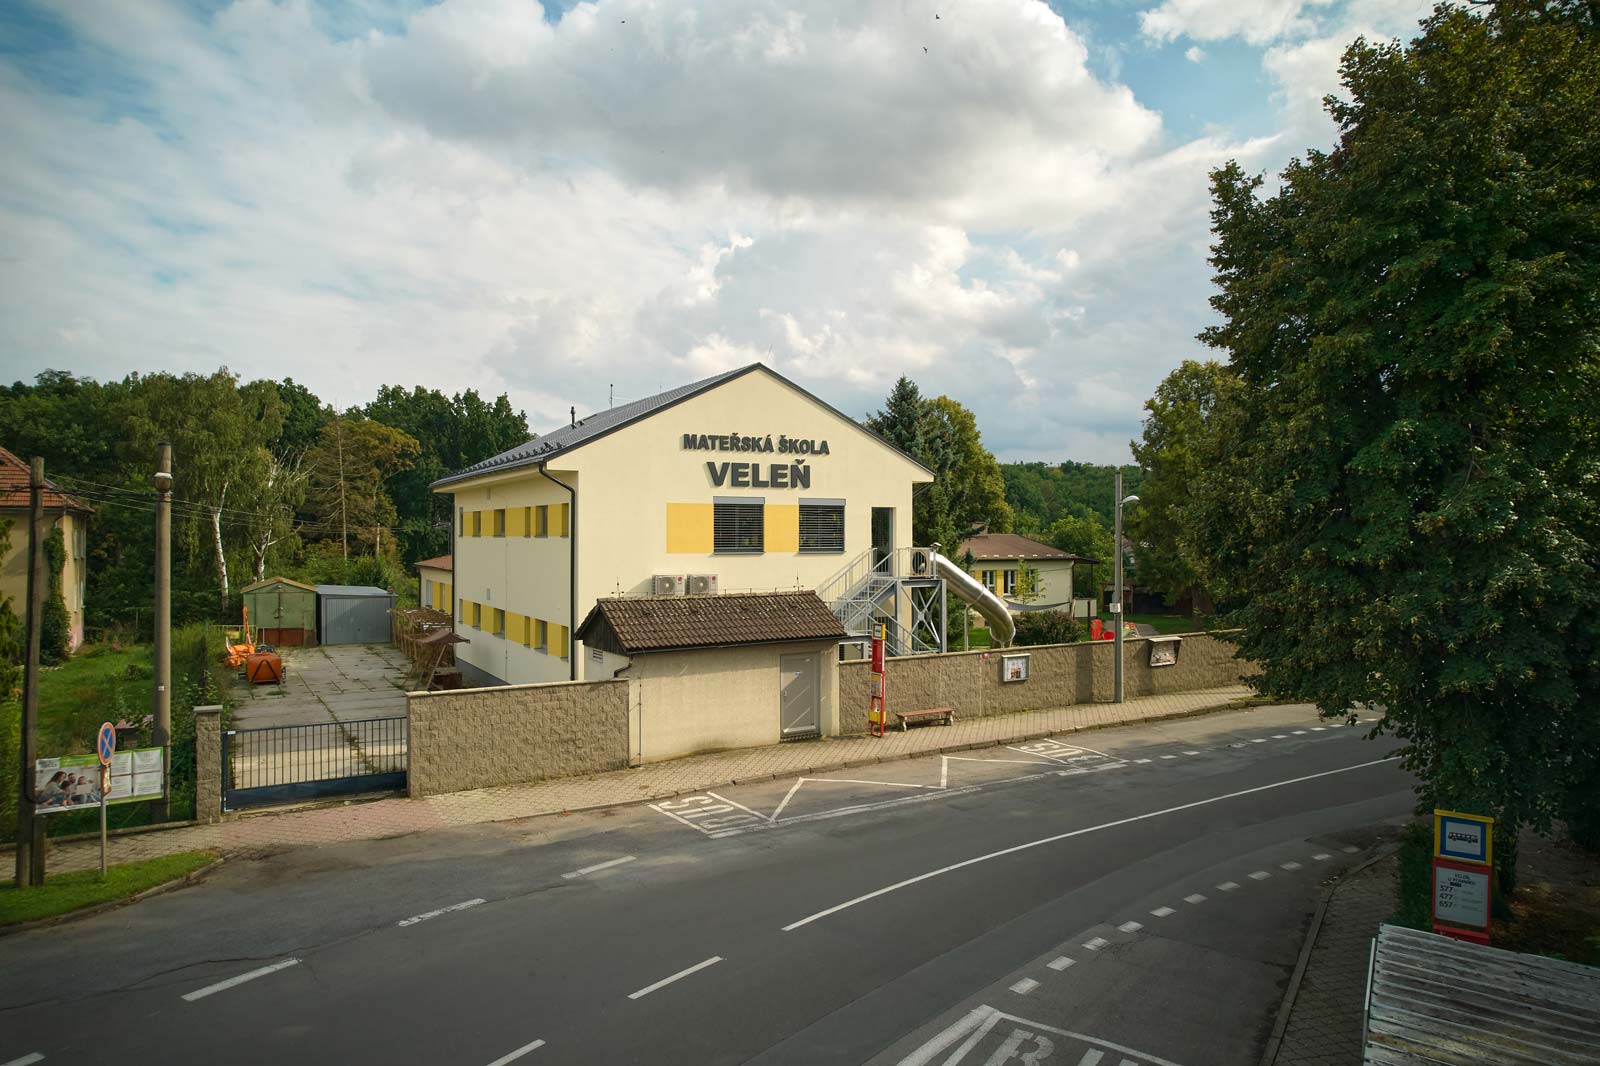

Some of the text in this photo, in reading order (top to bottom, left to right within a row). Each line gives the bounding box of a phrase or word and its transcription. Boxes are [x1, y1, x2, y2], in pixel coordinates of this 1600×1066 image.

[683, 432, 830, 455] MATEŘSKÁ ŠKOLA
[706, 458, 811, 489] VELEŇ
